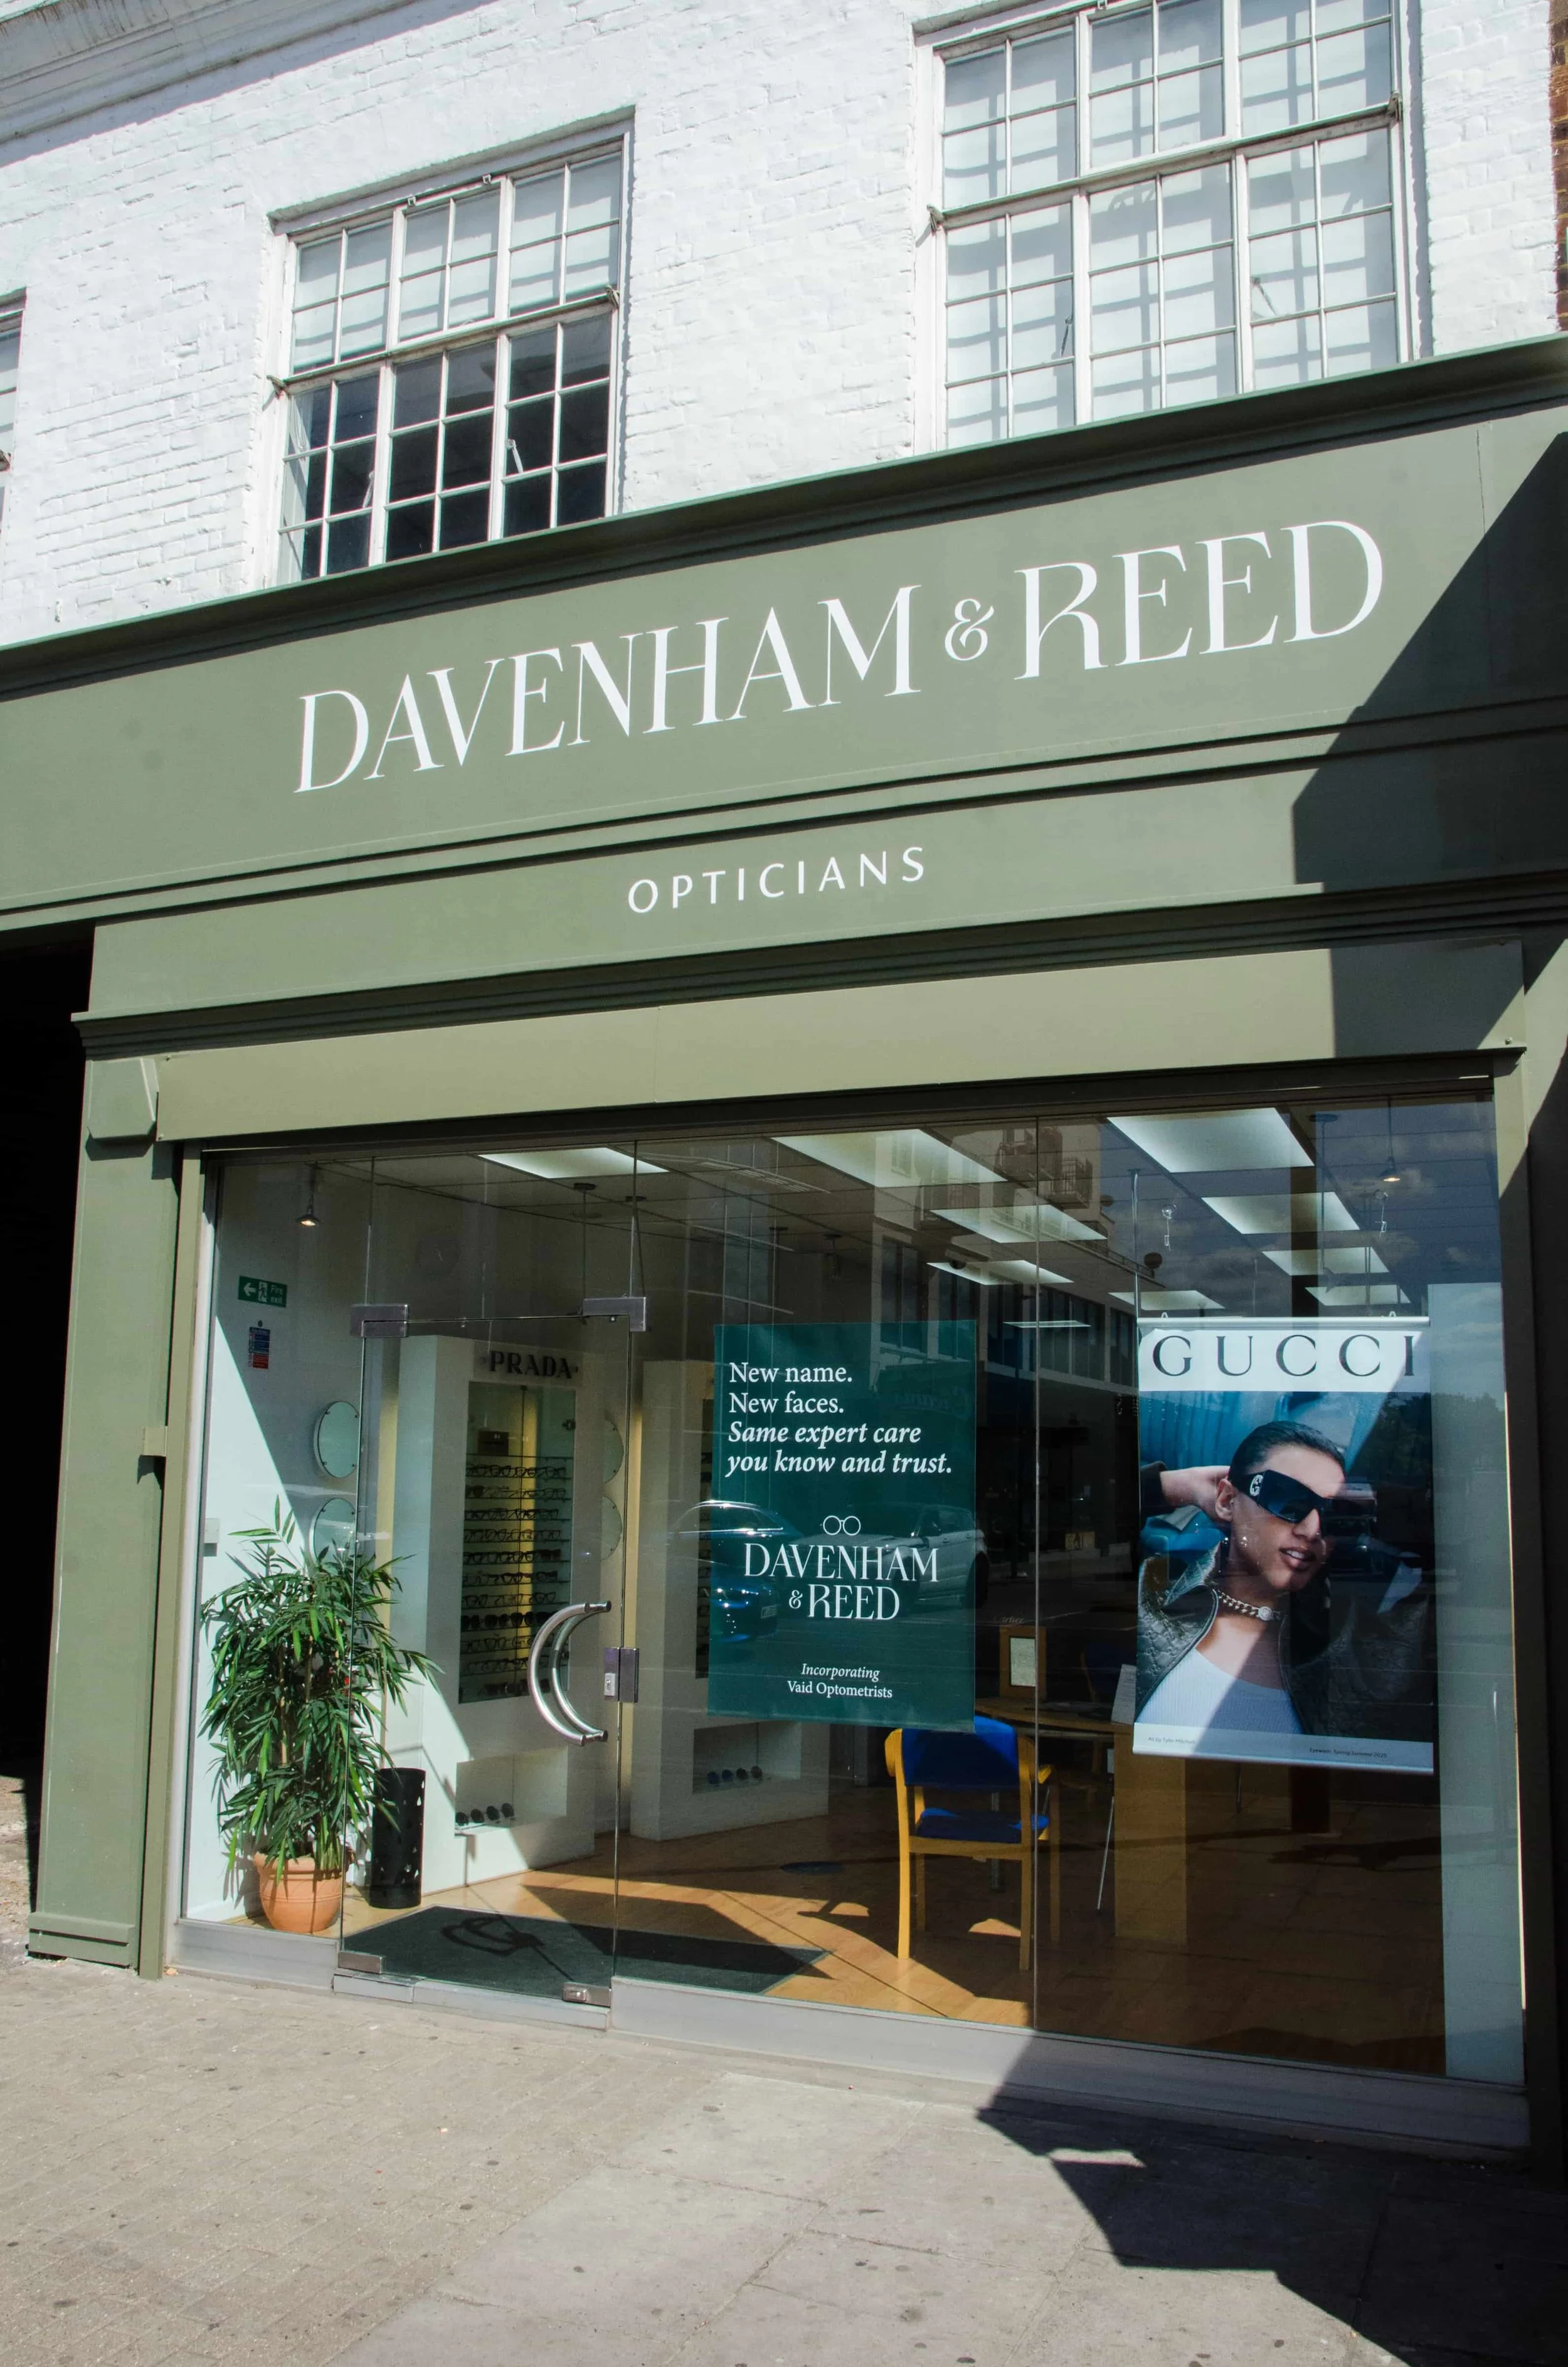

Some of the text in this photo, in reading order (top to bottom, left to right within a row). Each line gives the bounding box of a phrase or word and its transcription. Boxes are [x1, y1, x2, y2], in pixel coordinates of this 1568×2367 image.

[294, 521, 1383, 793] DAVENHAM & REED
[628, 847, 924, 913] OPTICIANS
[270, 1284, 284, 1295] Fire
[270, 1294, 283, 1305] exit
[489, 1350, 572, 1379] PRADA
[1152, 1334, 1415, 1377] GUCCI
[729, 1362, 852, 1382] New name.
[729, 1390, 844, 1413] New faces.
[728, 1421, 921, 1449] Same expert care
[725, 1449, 952, 1478] you know and trust.
[744, 1543, 939, 1582] DAVENHAM
[788, 1589, 803, 1609] &
[808, 1584, 900, 1620] REED
[801, 1663, 880, 1682] Incorporating
[787, 1681, 893, 1698] Vaid Optometrists
